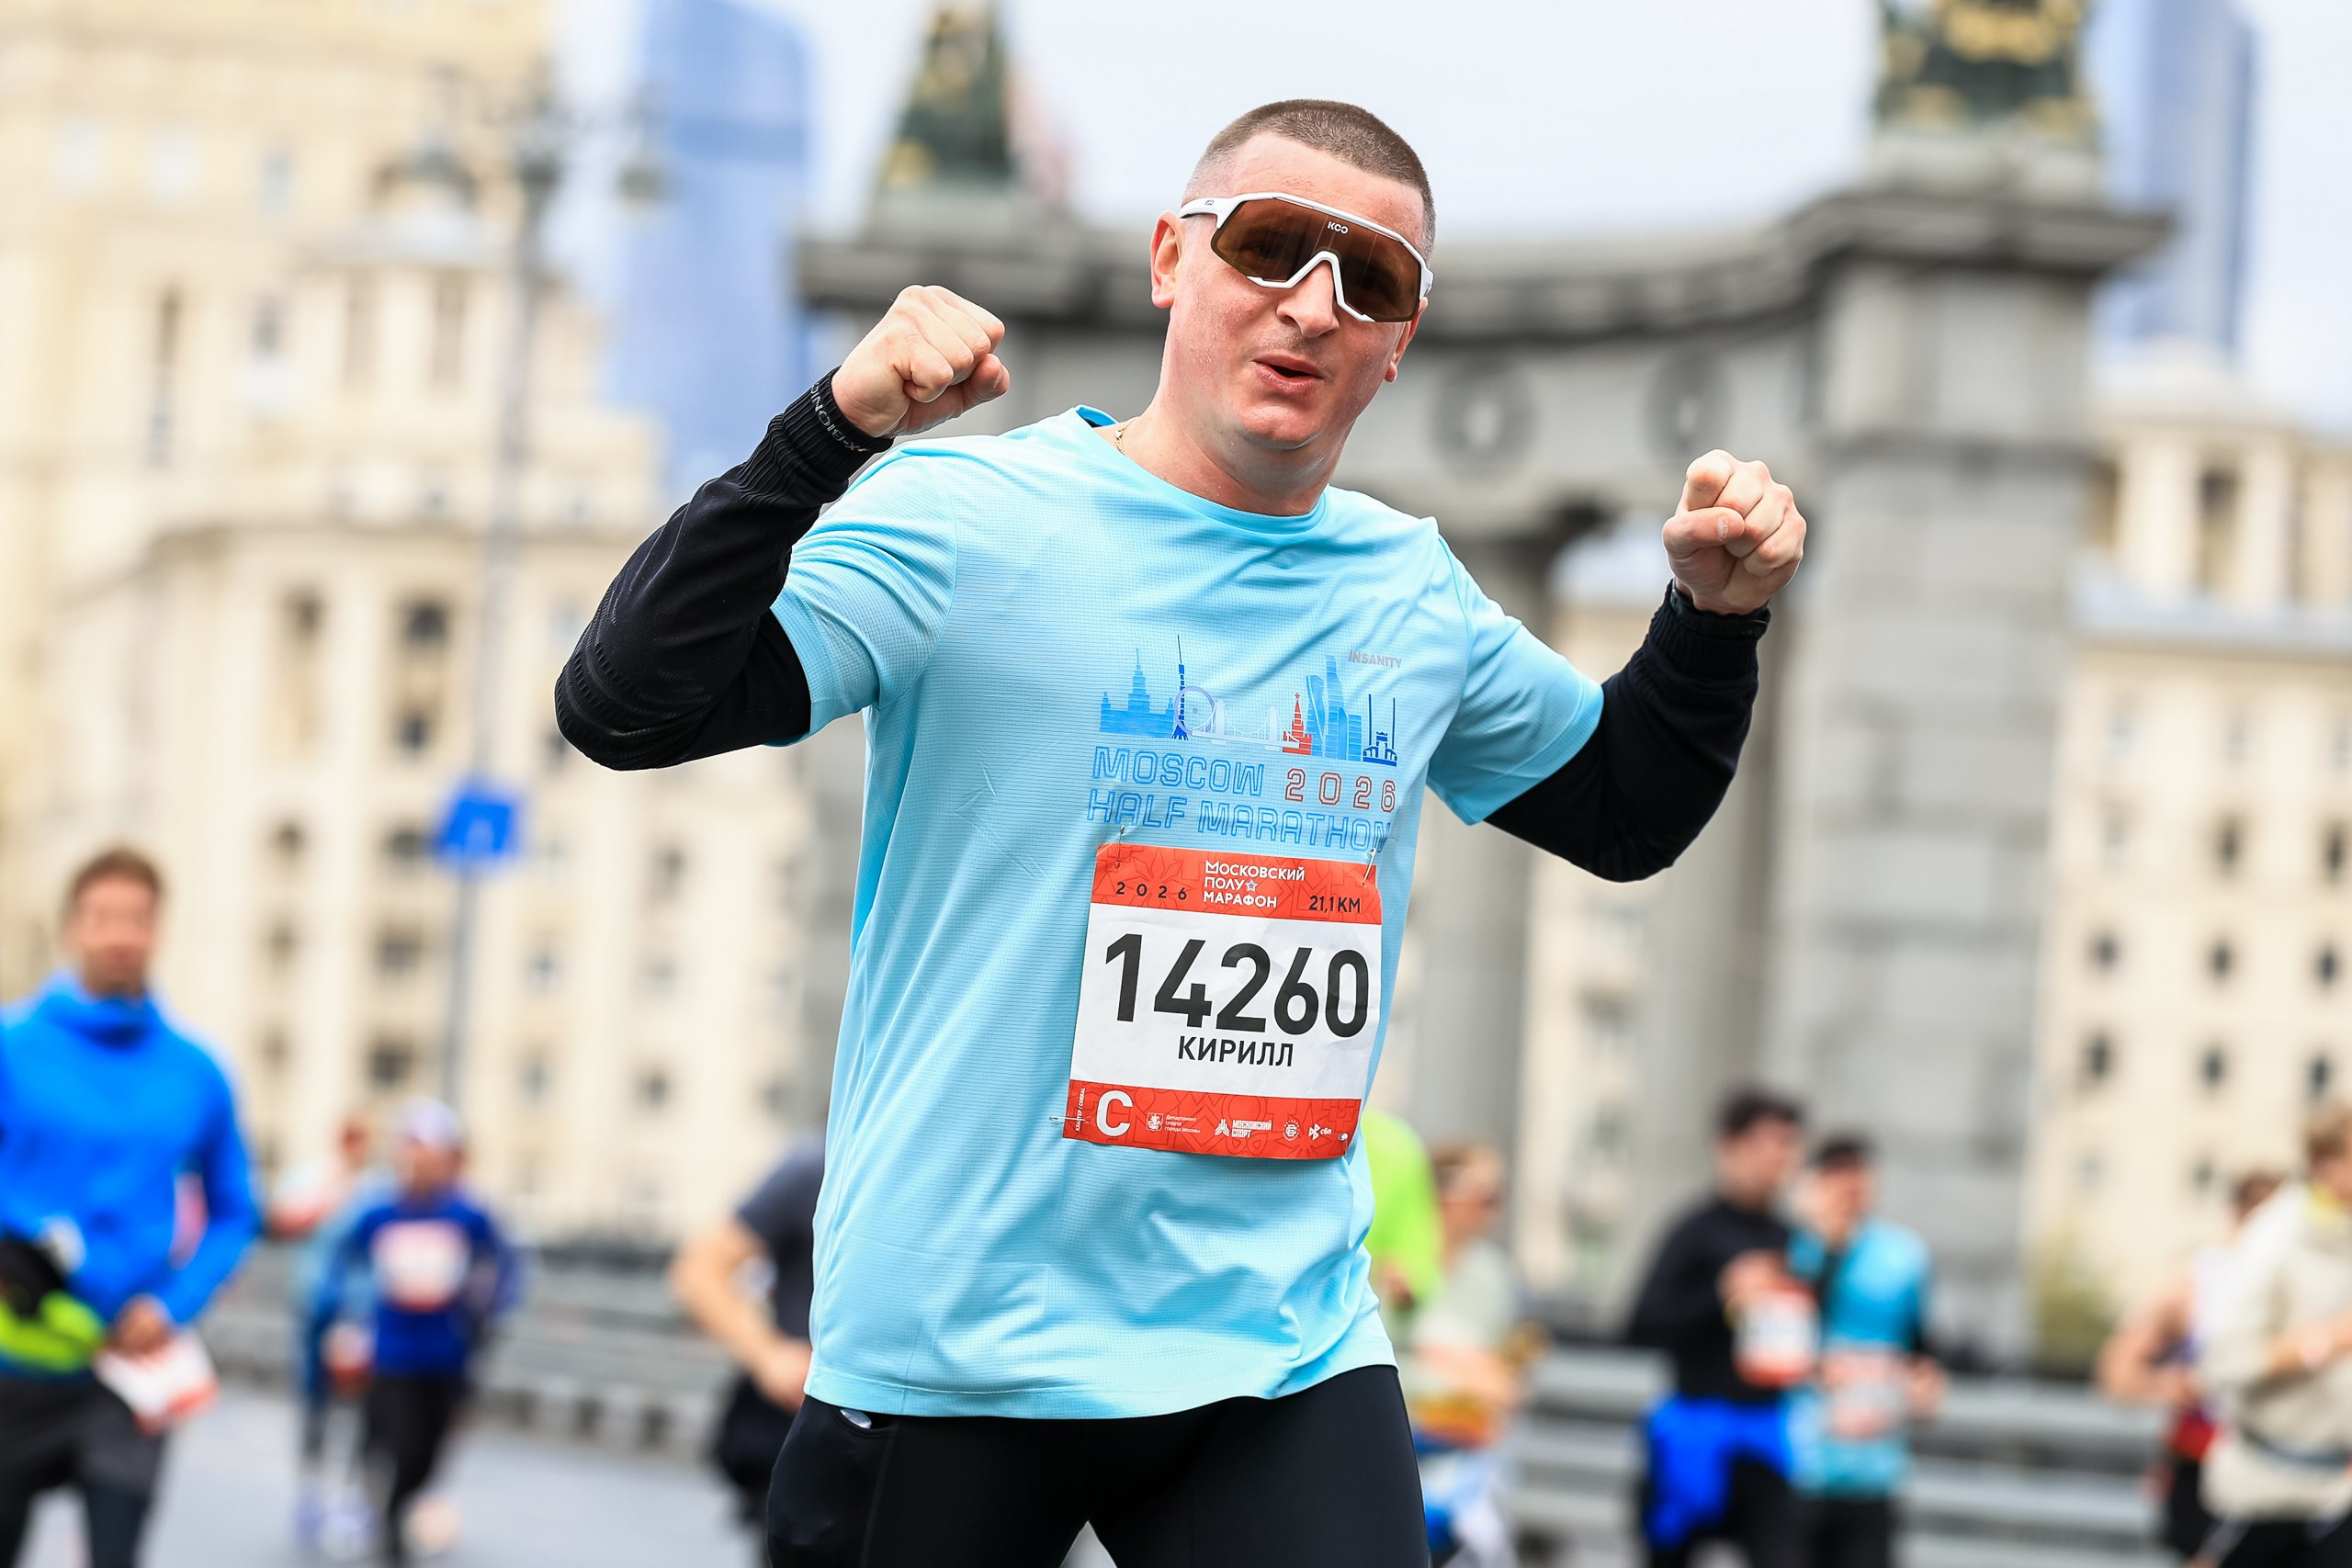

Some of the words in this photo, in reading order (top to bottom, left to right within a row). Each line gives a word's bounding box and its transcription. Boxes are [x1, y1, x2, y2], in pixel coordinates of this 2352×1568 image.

[1348, 649, 1403, 669] INSANITY
[1091, 745, 1265, 797] MOSCOW
[1284, 767, 1396, 813] 2026
[1086, 788, 1188, 829] HALF
[1197, 800, 1392, 853] MARATHON
[1114, 881, 1188, 900] 2026
[1204, 875, 1246, 891] ПОЛУ
[1203, 890, 1278, 908] МАРАФОН
[1104, 932, 1370, 1038] 14260
[1177, 1034, 1295, 1067] КИРИЛЛ
[1231, 1119, 1272, 1131] МОСКОВСКИЙ
[1231, 1128, 1251, 1138] СПОРТ
